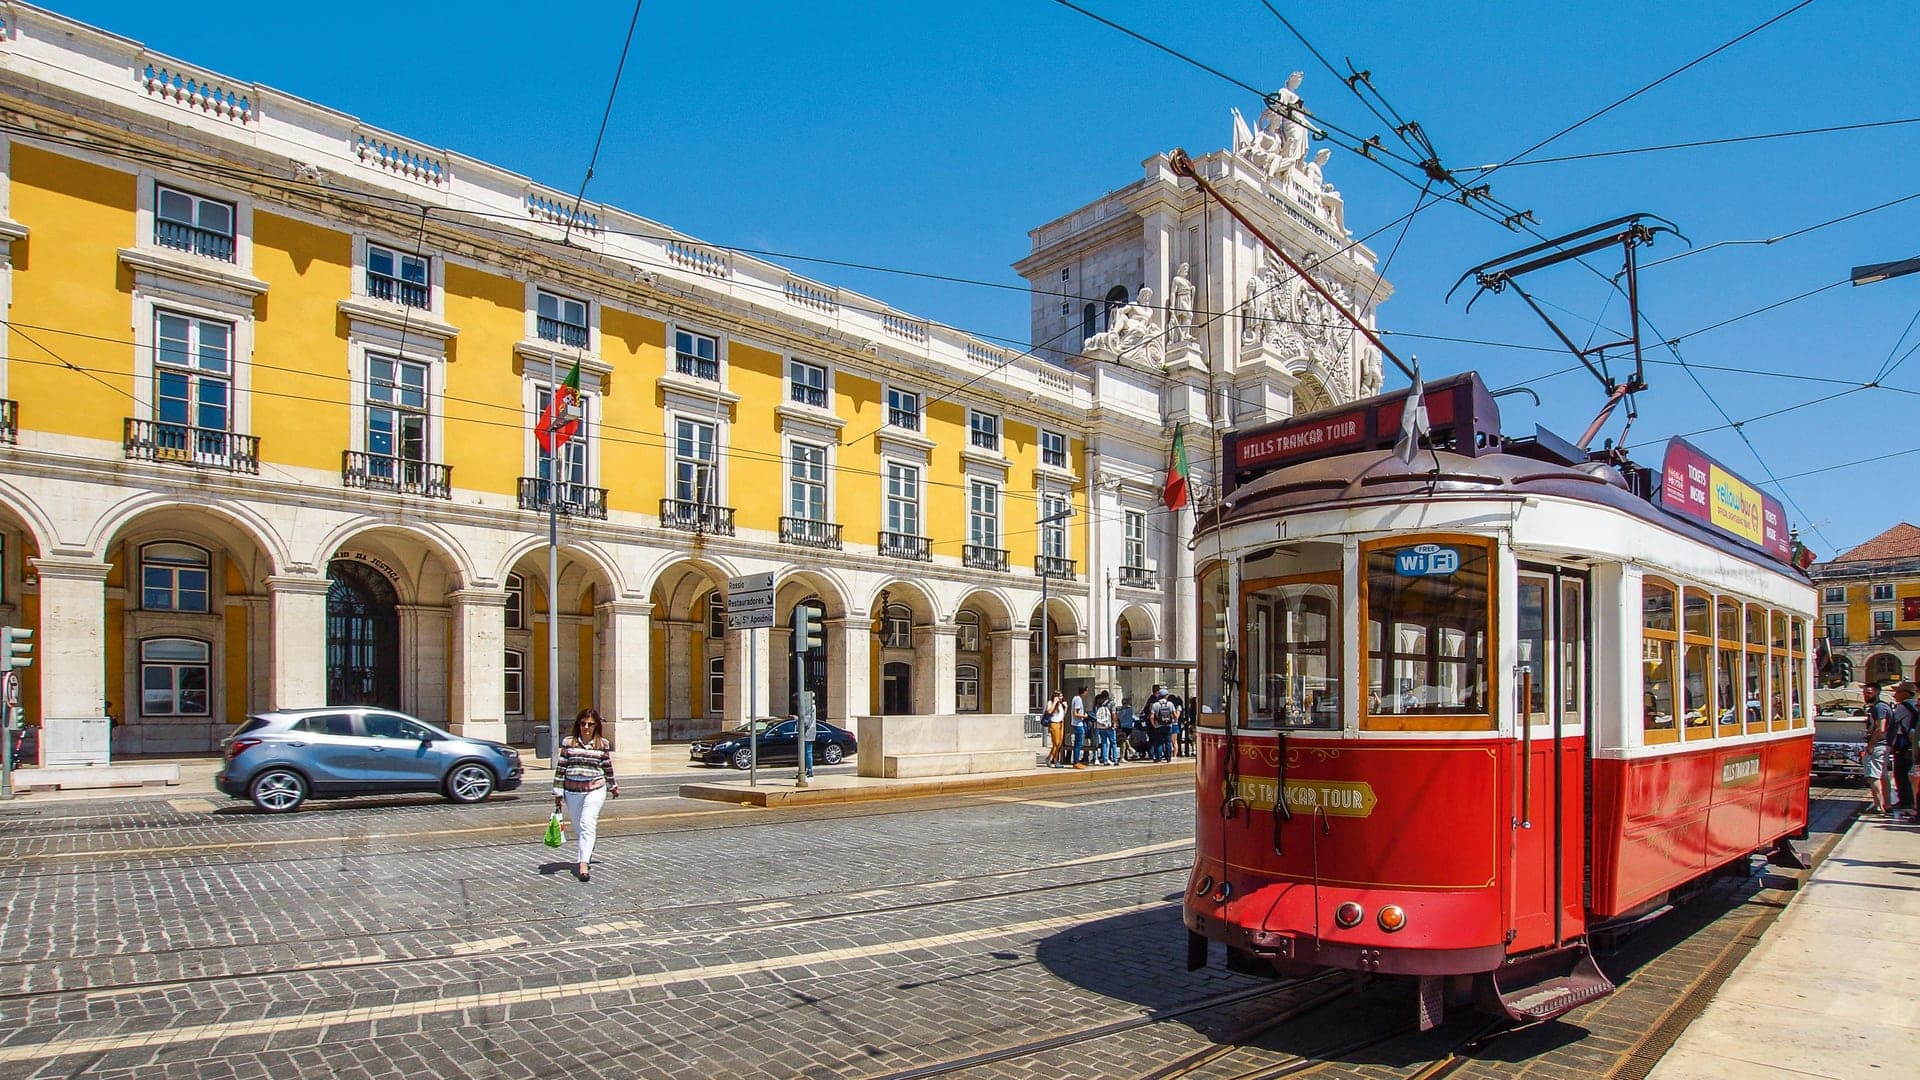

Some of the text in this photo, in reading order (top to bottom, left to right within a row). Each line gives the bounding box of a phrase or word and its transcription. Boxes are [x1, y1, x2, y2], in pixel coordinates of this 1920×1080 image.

[1243, 421, 1356, 459] HILLS TRAMCAR TOUR
[1275, 520, 1287, 539] 11
[729, 581, 744, 590] Rossio
[728, 597, 764, 608] Restauradores
[1321, 788, 1363, 809] TOUR
